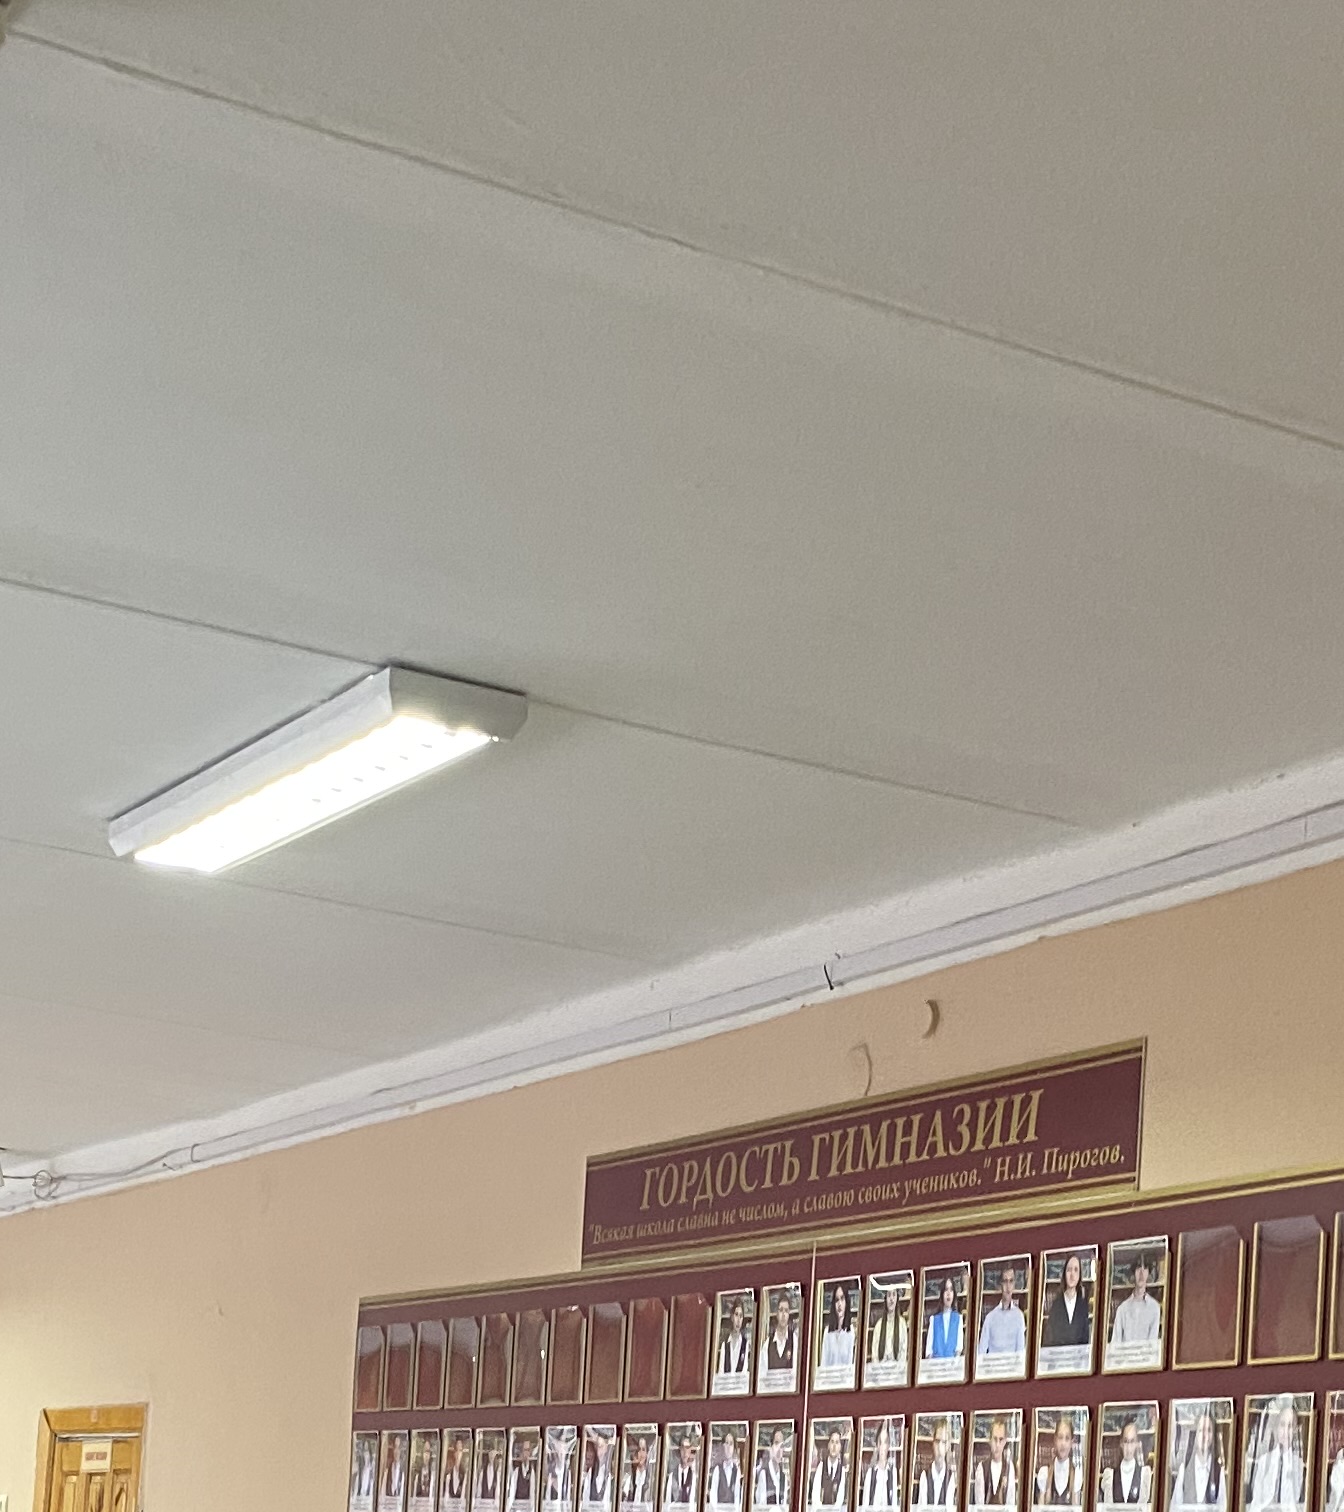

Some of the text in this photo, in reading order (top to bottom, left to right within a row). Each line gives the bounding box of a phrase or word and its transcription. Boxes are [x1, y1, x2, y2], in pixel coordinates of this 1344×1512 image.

[640, 1088, 1042, 1211] ГОРДОСТЬ ГИМНАЗИИ
[677, 1210, 719, 1233] славна
[721, 1208, 737, 1226] не
[739, 1201, 789, 1222] числом,
[791, 1199, 801, 1216] а
[804, 1187, 855, 1213] славою
[858, 1179, 901, 1205] своих
[994, 1151, 1036, 1184] Н.И.
[1041, 1143, 1125, 1180] Пирогов.
